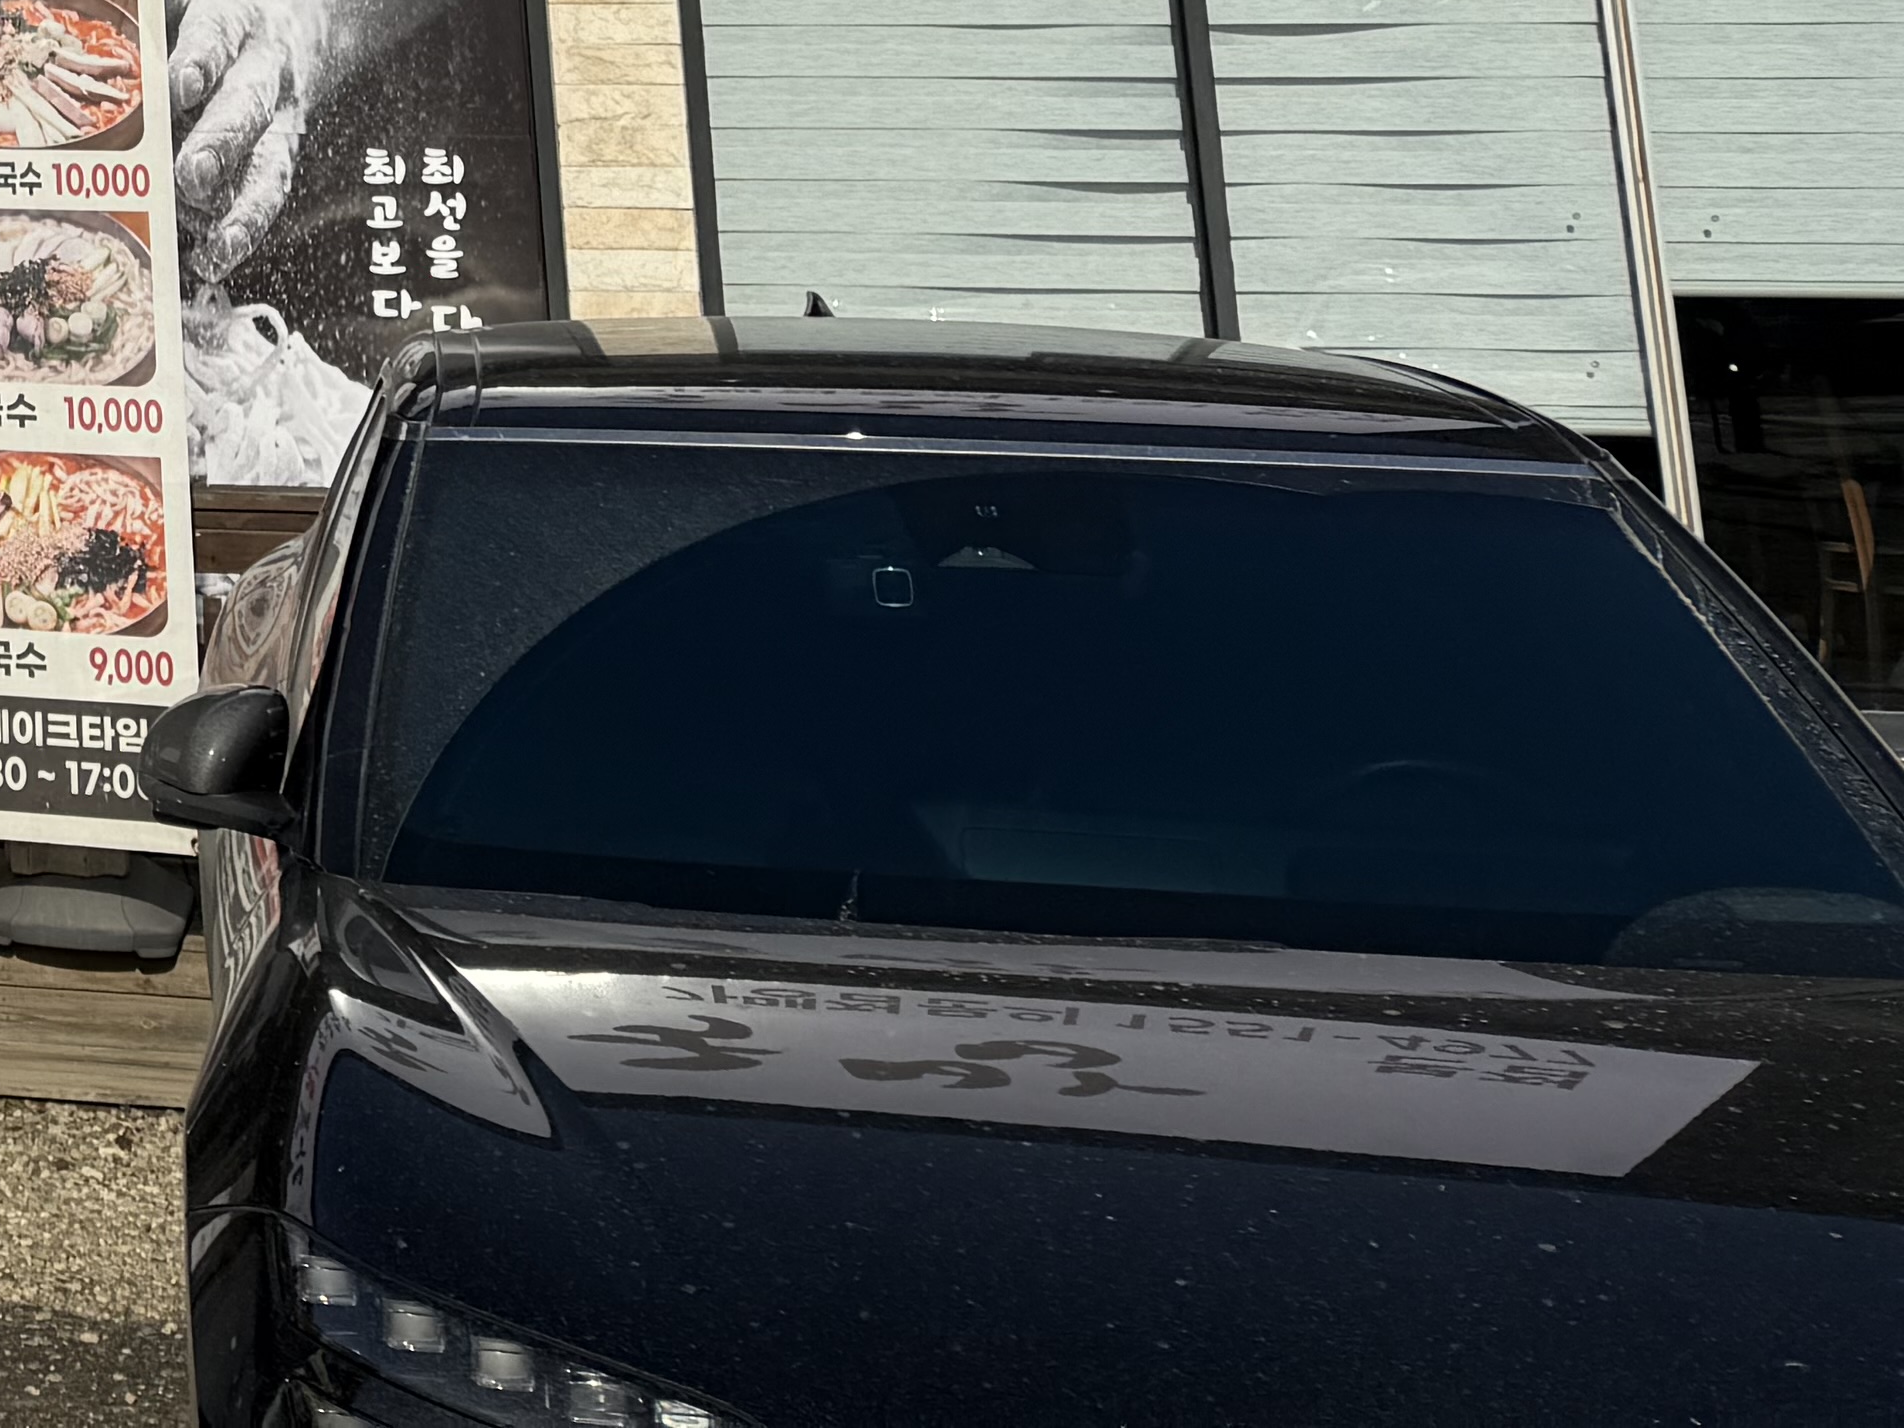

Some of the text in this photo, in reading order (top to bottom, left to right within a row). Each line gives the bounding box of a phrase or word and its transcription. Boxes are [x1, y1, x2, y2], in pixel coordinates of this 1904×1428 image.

[52, 163, 150, 199] 10,000
[64, 395, 163, 434] 10,000
[89, 647, 174, 687] 9,000
